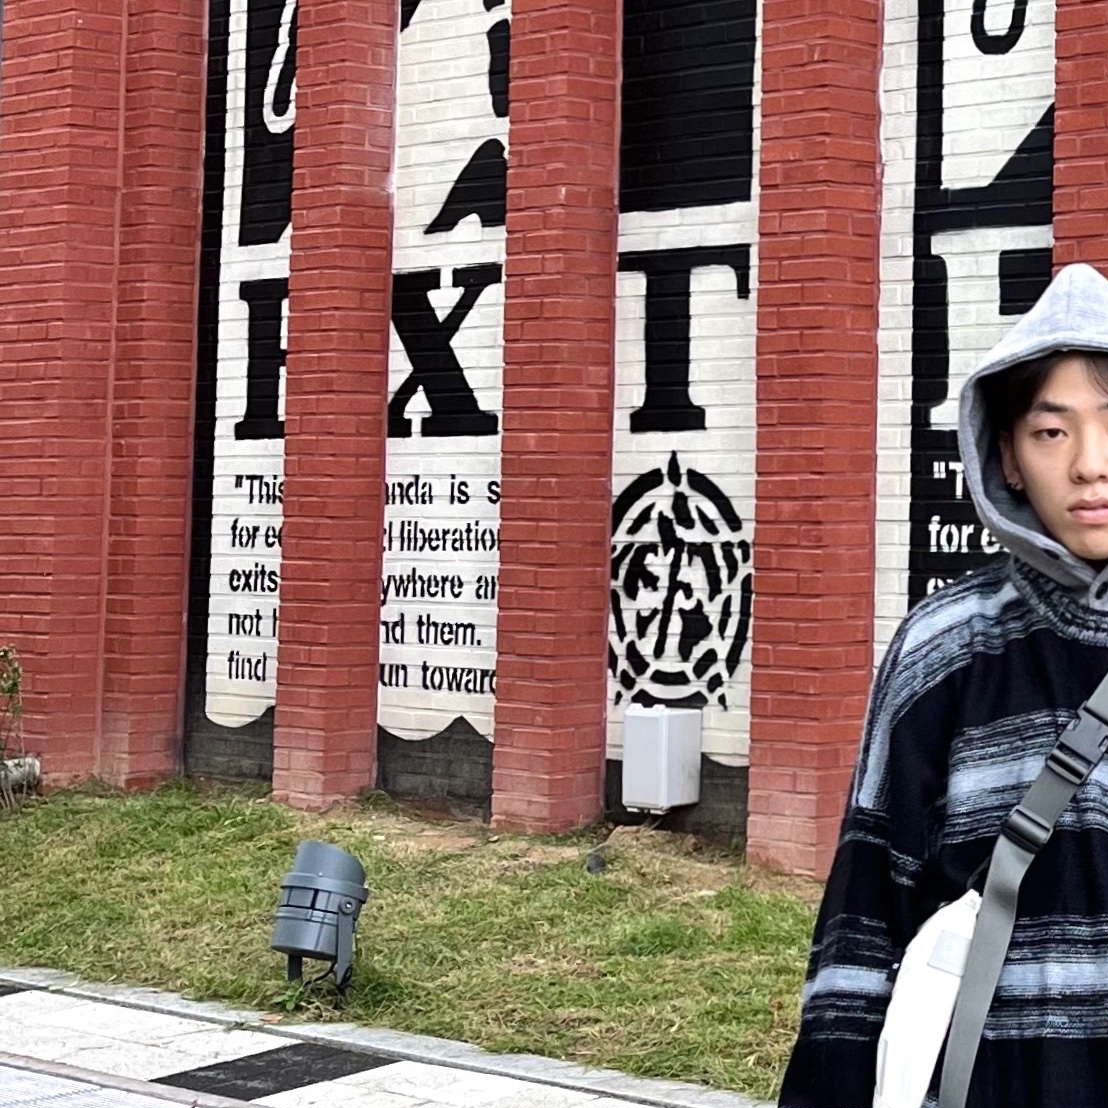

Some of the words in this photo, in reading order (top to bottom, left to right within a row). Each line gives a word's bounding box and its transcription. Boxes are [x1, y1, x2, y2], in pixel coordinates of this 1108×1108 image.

[449, 474, 470, 505] is
[231, 517, 260, 548] for
[399, 520, 500, 552] liberatio
[928, 515, 974, 553] for
[229, 562, 280, 593] exits
[381, 567, 464, 607] ywhere
[228, 609, 262, 637] not
[416, 613, 482, 646] them.
[227, 650, 267, 682] find
[421, 661, 496, 695] towar
